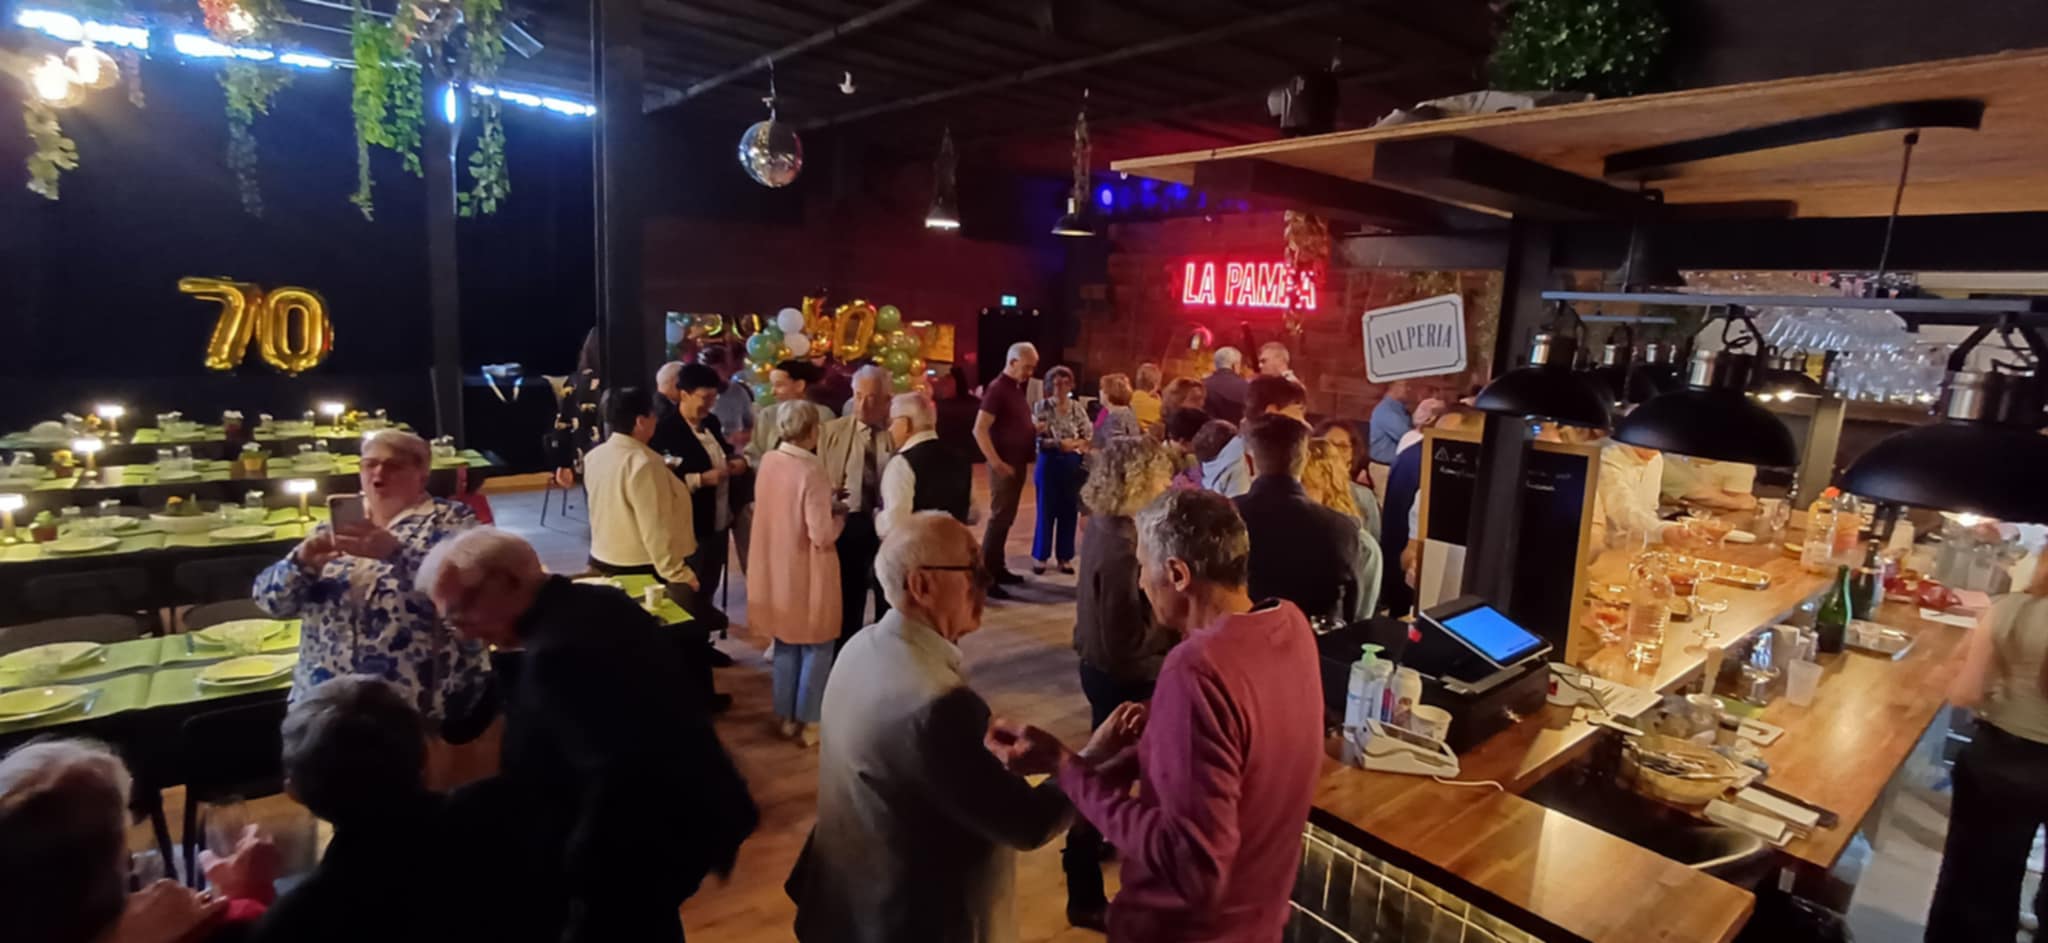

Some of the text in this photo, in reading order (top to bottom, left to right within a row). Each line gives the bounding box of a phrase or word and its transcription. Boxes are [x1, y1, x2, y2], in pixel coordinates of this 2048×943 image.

[1182, 261, 1217, 305] LA
[177, 275, 335, 372] 70
[1375, 322, 1453, 360] PULPERIA
